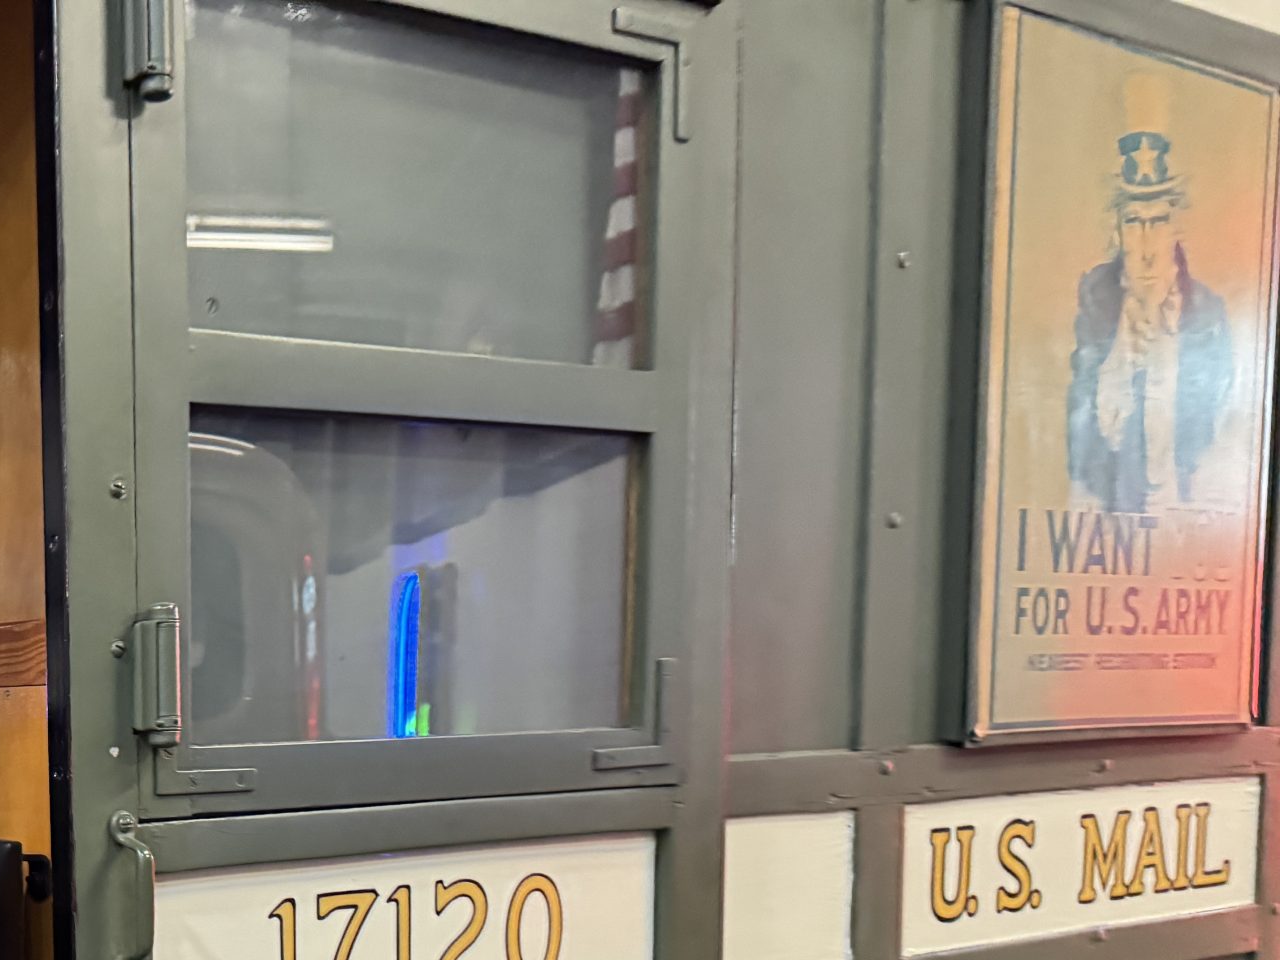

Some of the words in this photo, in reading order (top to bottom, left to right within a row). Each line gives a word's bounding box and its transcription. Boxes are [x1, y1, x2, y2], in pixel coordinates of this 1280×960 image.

[1016, 508, 1027, 571] I
[1045, 509, 1158, 576] WANT
[1014, 586, 1069, 635] FOR
[930, 818, 1042, 923] U.S.
[1078, 802, 1231, 904] MAIL
